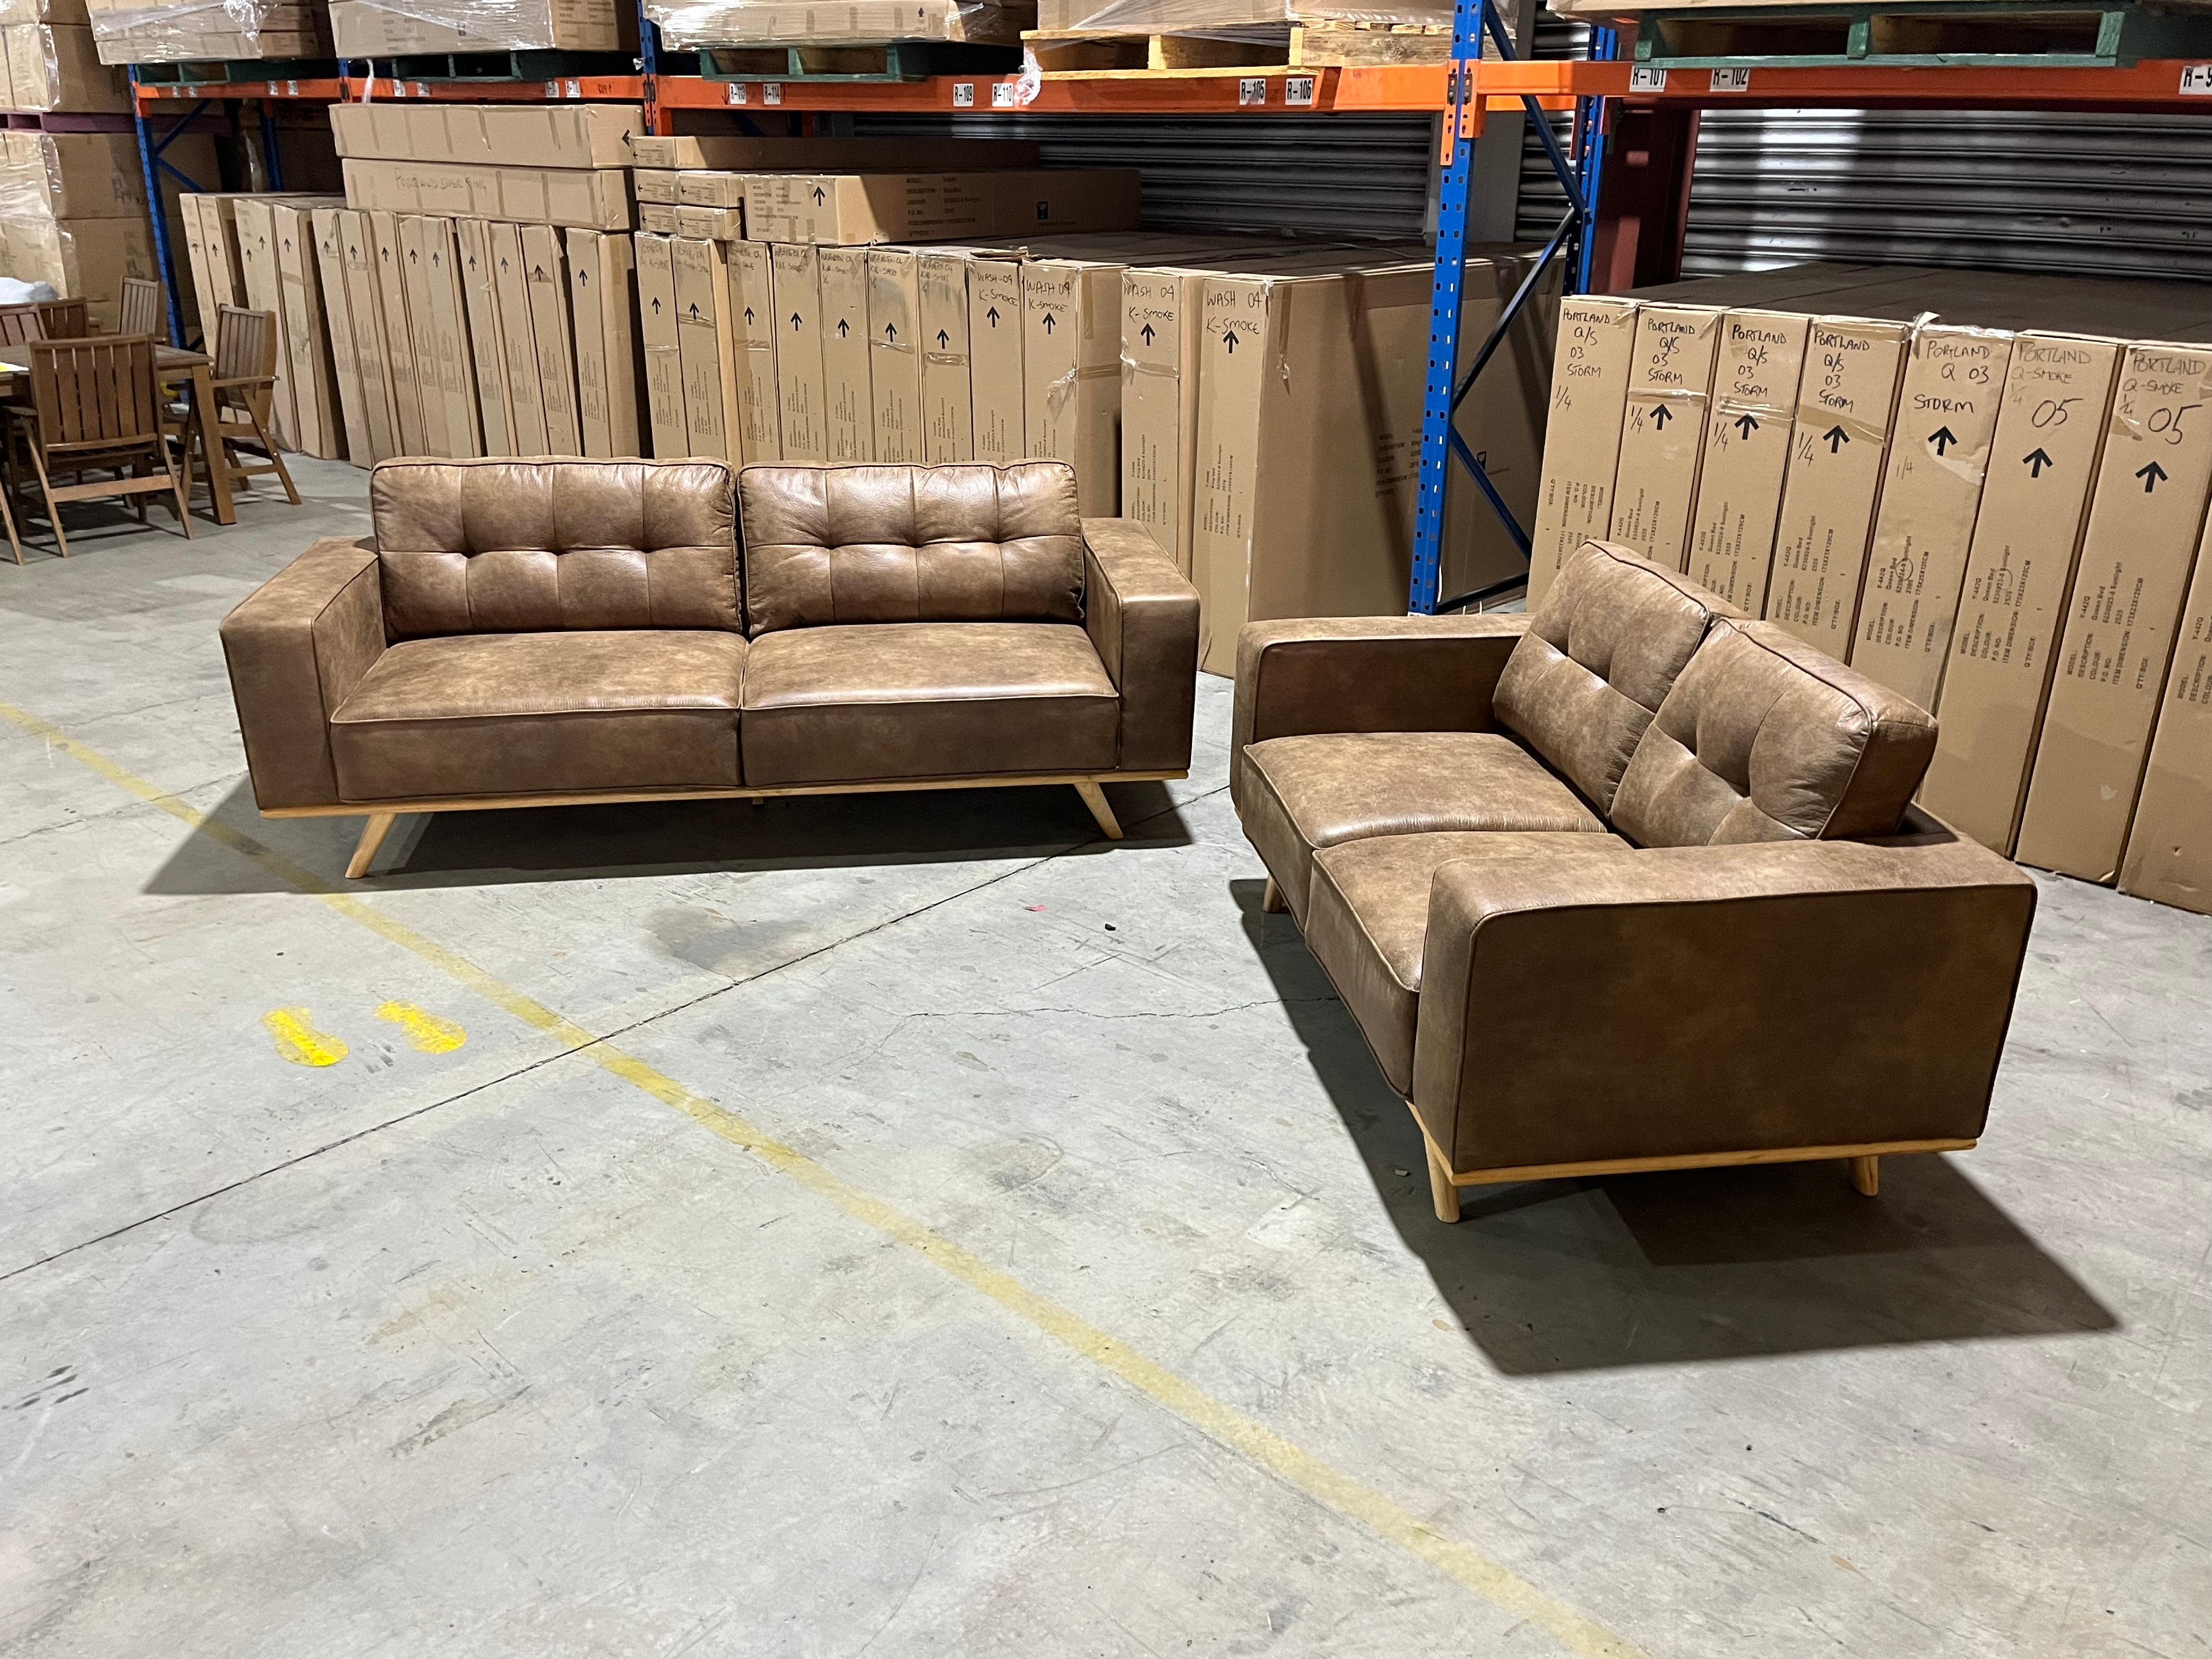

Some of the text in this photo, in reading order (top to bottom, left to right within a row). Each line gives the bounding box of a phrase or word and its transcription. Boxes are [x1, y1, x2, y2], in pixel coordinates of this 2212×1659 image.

[1633, 68, 1664, 86] R-101
[1713, 68, 1748, 85] R-102
[994, 85, 1012, 101] R-110
[1241, 81, 1264, 99] R-105
[1288, 80, 1311, 99] R-106
[1026, 280, 1055, 295] WASH
[1160, 285, 1175, 301] 04
[1207, 290, 1262, 308] WASH 04
[1564, 308, 1610, 324] PORTLAND
[1648, 318, 1695, 335] PORTLAND
[1732, 324, 1786, 343] PORTLAND
[1814, 330, 1870, 351] PORTLAND
[1927, 340, 1990, 359] PORTLAND
[1571, 347, 1584, 359] 03
[1652, 353, 1668, 366] 03
[2019, 341, 2091, 364] PORTLAND
[1567, 364, 1601, 377] STORM
[1738, 365, 1754, 379] 03
[2132, 353, 2206, 375] PORTLAND
[1649, 368, 1682, 384] STORM
[1825, 374, 1841, 389] 03
[1941, 363, 1989, 384] Q 03
[1734, 381, 1768, 397] STORM
[1819, 389, 1854, 413] STORM
[1914, 394, 1974, 413] STORM
[2032, 398, 2084, 428] 05
[2148, 404, 2203, 445] 05
[1886, 571, 1894, 590] Queen
[1983, 582, 1991, 601] Queen
[2091, 600, 2101, 620] Queen
